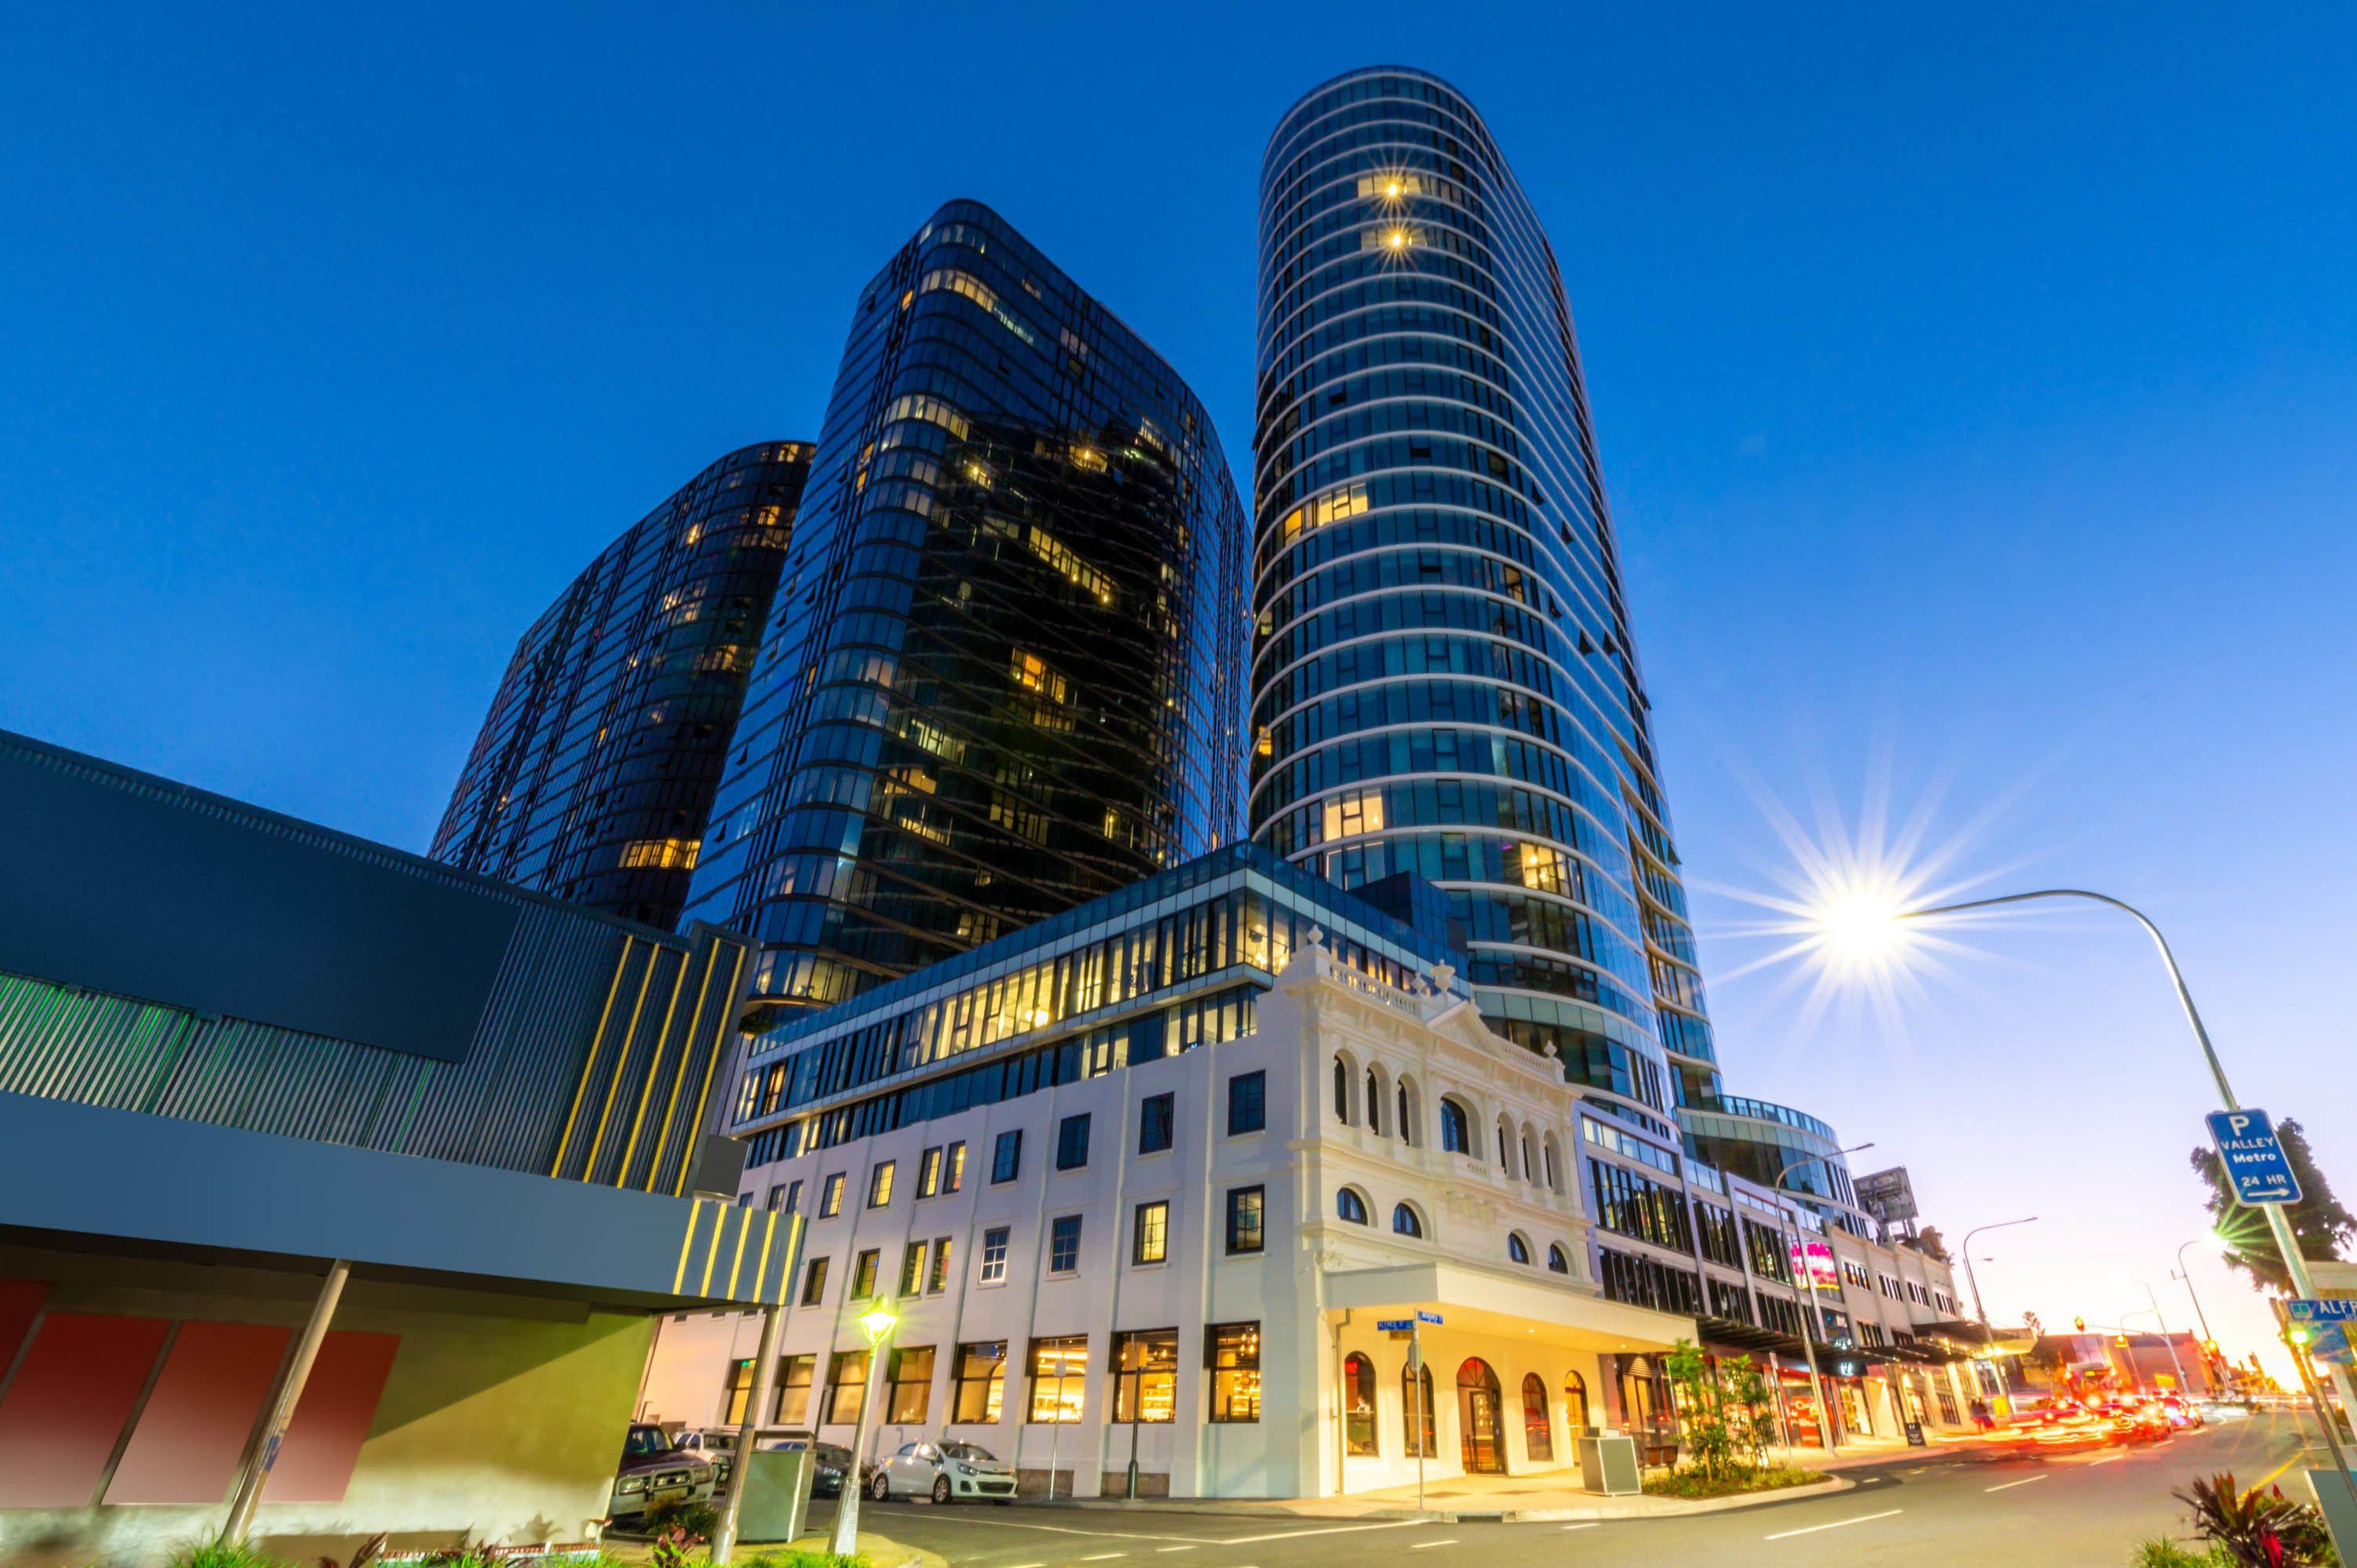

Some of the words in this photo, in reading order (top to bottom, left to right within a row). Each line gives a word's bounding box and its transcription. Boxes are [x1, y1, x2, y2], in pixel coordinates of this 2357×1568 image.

[2228, 1115, 2250, 1137] P
[2221, 1137, 2273, 1150] VALLEY
[2232, 1152, 2276, 1163] Metro
[2241, 1176, 2260, 1187] 24
[2265, 1174, 2287, 1185] HR
